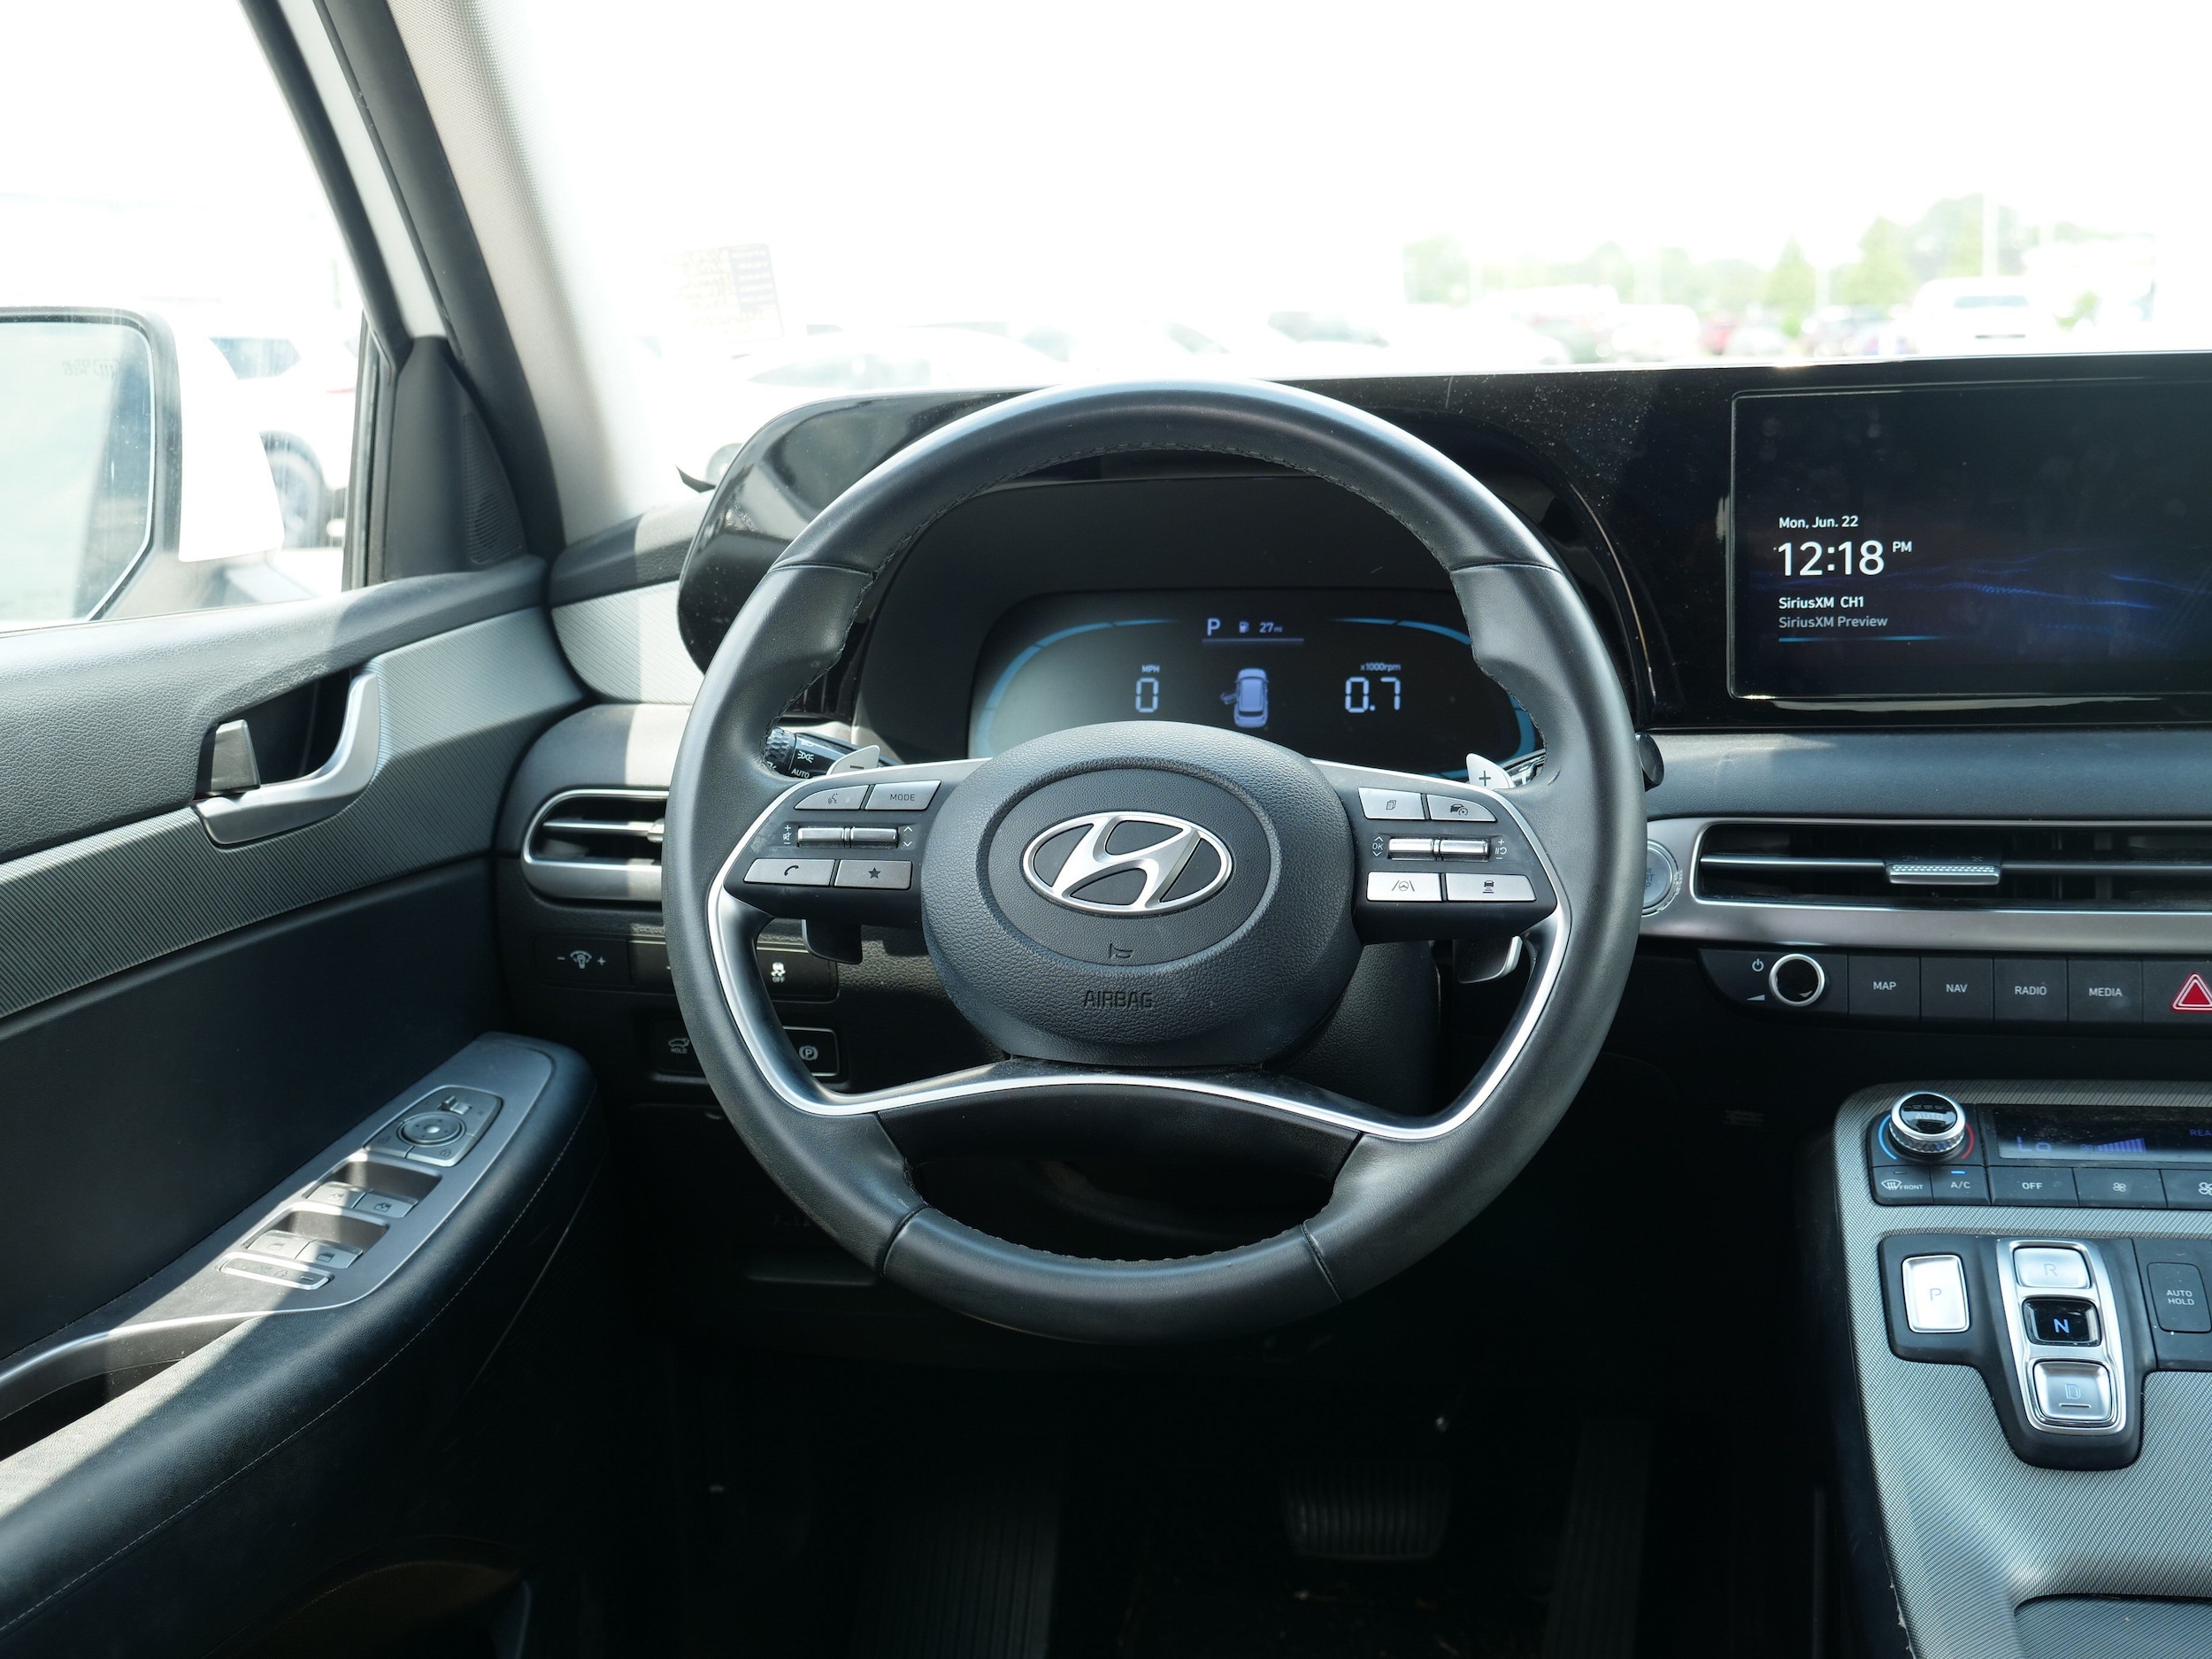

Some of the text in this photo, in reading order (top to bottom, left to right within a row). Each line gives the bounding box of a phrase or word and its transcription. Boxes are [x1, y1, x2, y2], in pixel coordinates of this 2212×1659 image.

[1778, 515, 1859, 529] Mon, Jun. 22
[1778, 540, 1913, 576] 12:18 PM
[1778, 595, 1864, 609] SiriusXM CH1
[1207, 618, 1221, 636] P
[1778, 615, 1888, 628] SiriusXM Preview
[1135, 677, 1159, 713] 0
[1345, 676, 1402, 713] 0.7
[790, 767, 810, 779] AUTO
[889, 793, 916, 802] MODE
[1872, 981, 1897, 991] MAP
[1946, 983, 1968, 994] NAV
[2014, 986, 2047, 996] RADIO
[2088, 987, 2123, 997] MEDIA
[1083, 989, 1153, 1010] AIRBAG
[1950, 1180, 1971, 1189] A/C
[2022, 1181, 2043, 1190] OFF
[2044, 1263, 2057, 1277] R
[1930, 1287, 1942, 1302] P
[2166, 1288, 2193, 1298] AUTO
[2168, 1296, 2195, 1306] HOLD
[2053, 1318, 2070, 1334] N
[2064, 1382, 2081, 1401] D
